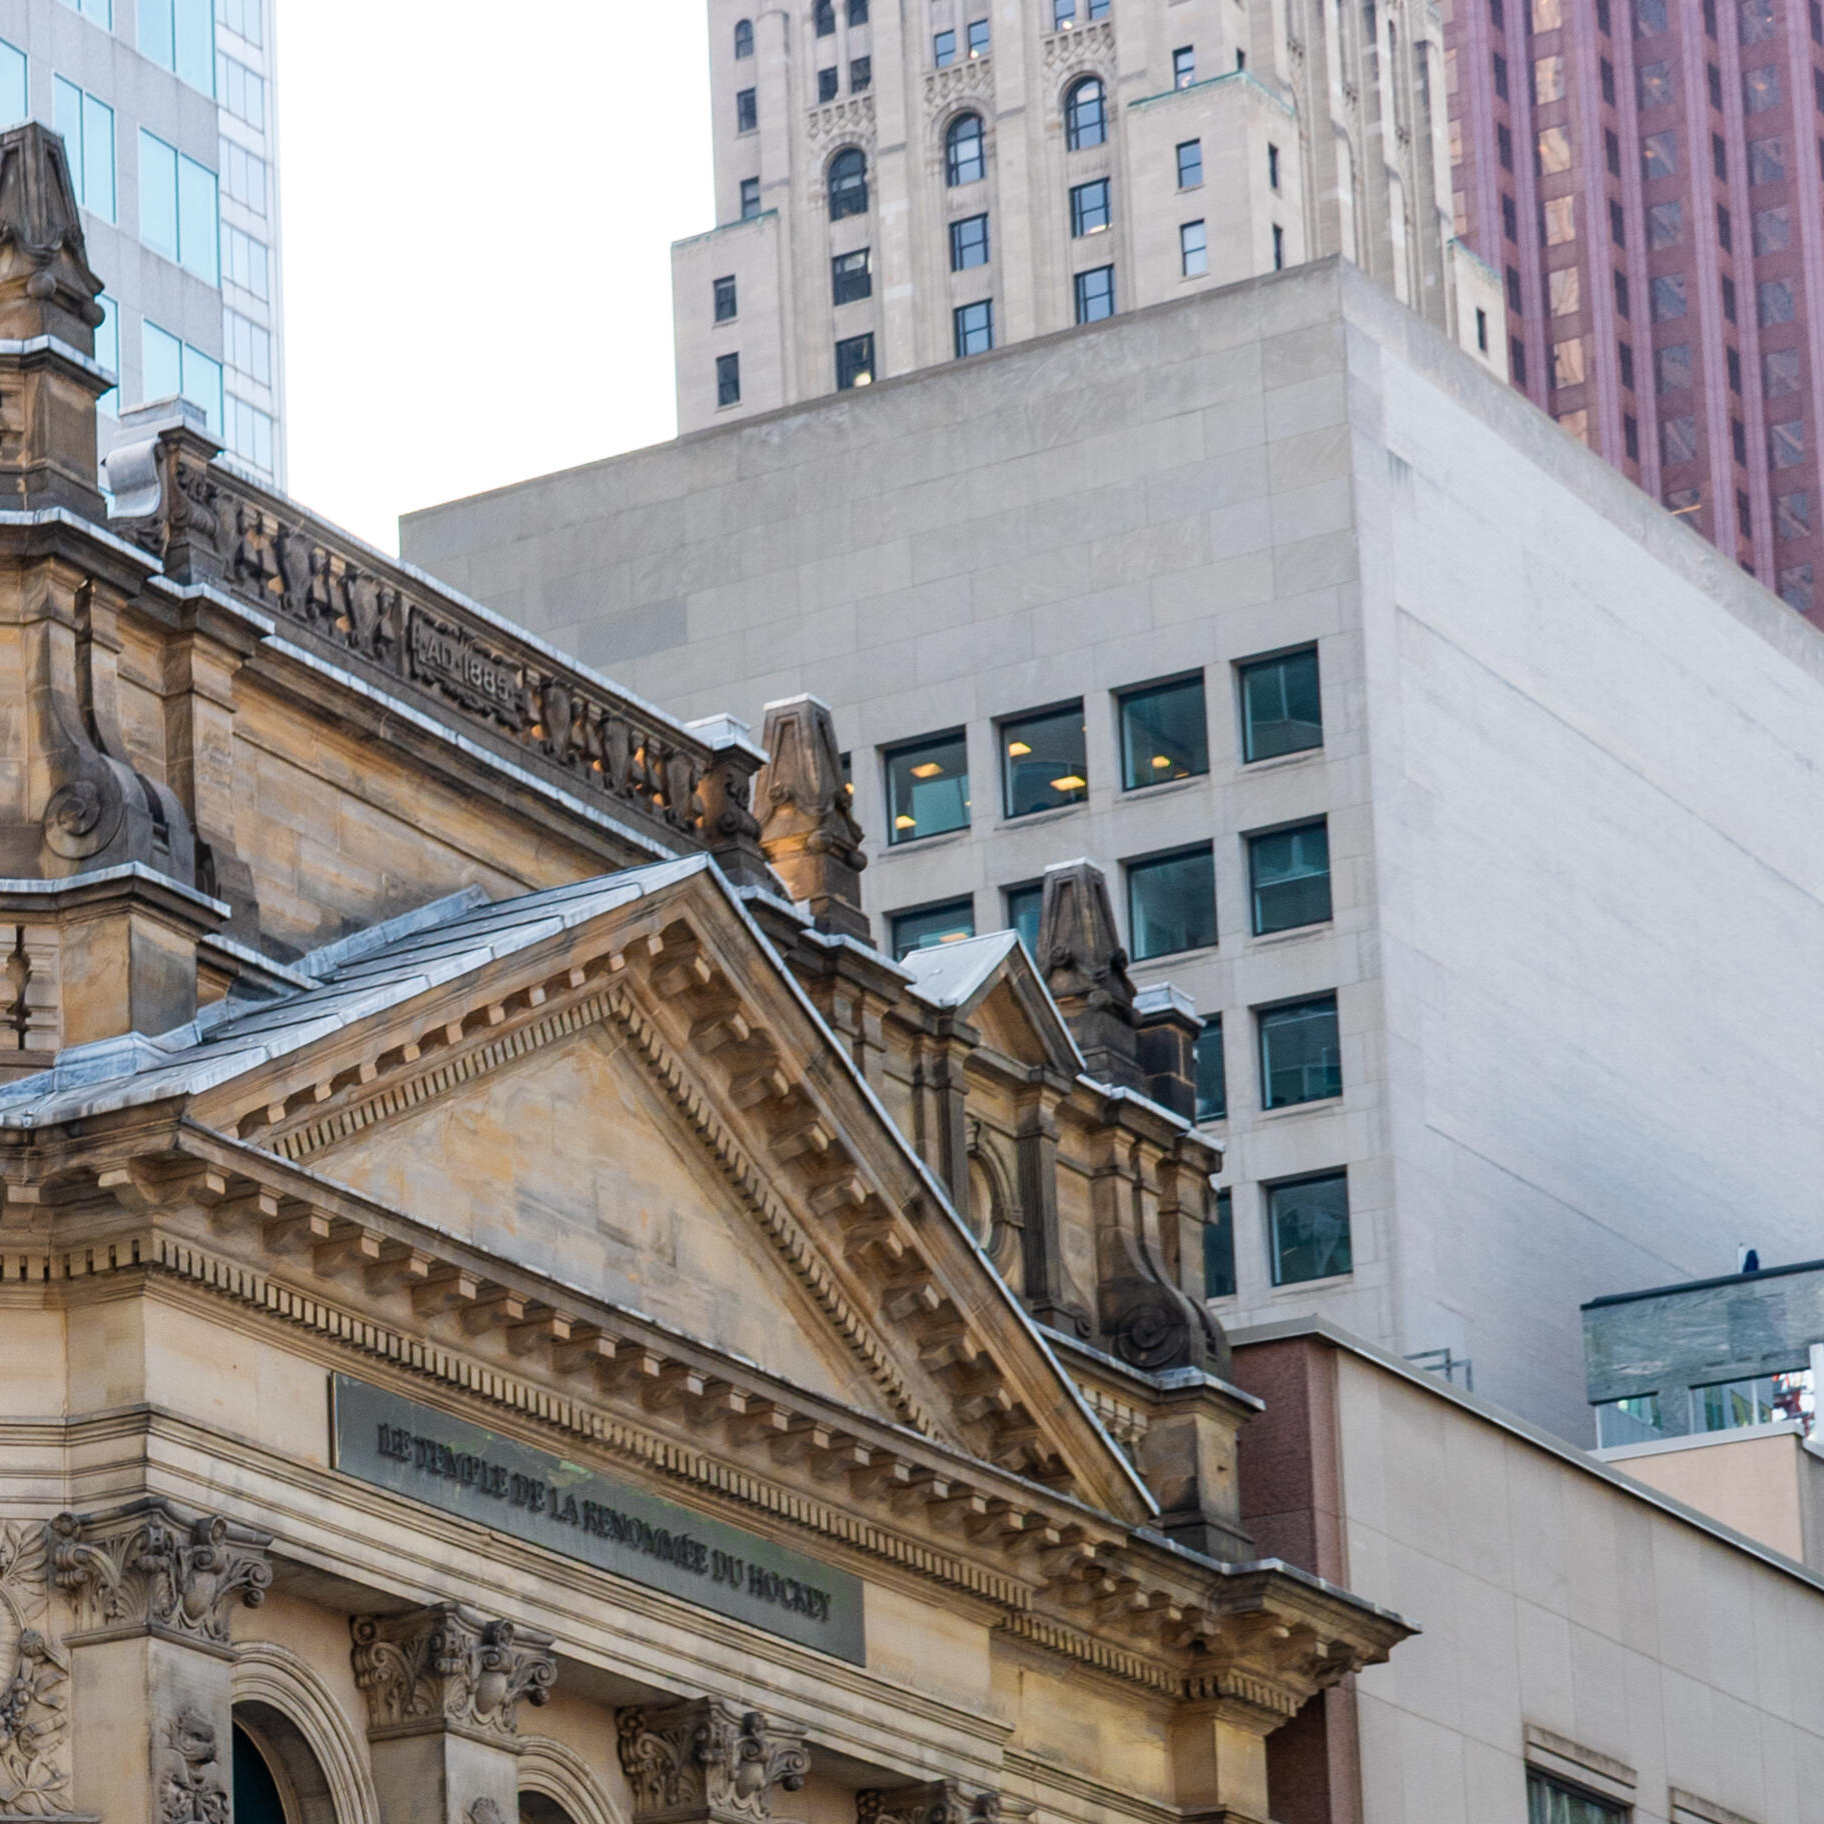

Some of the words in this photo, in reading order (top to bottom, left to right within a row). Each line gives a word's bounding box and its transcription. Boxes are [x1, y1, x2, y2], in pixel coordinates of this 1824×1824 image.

[376, 1422, 412, 1463] LE
[412, 1435, 508, 1499] TEMPLE
[509, 1472, 546, 1513] DE
[547, 1486, 580, 1527] LA
[711, 1549, 746, 1590] DU
[747, 1563, 832, 1624] HOCKEY
